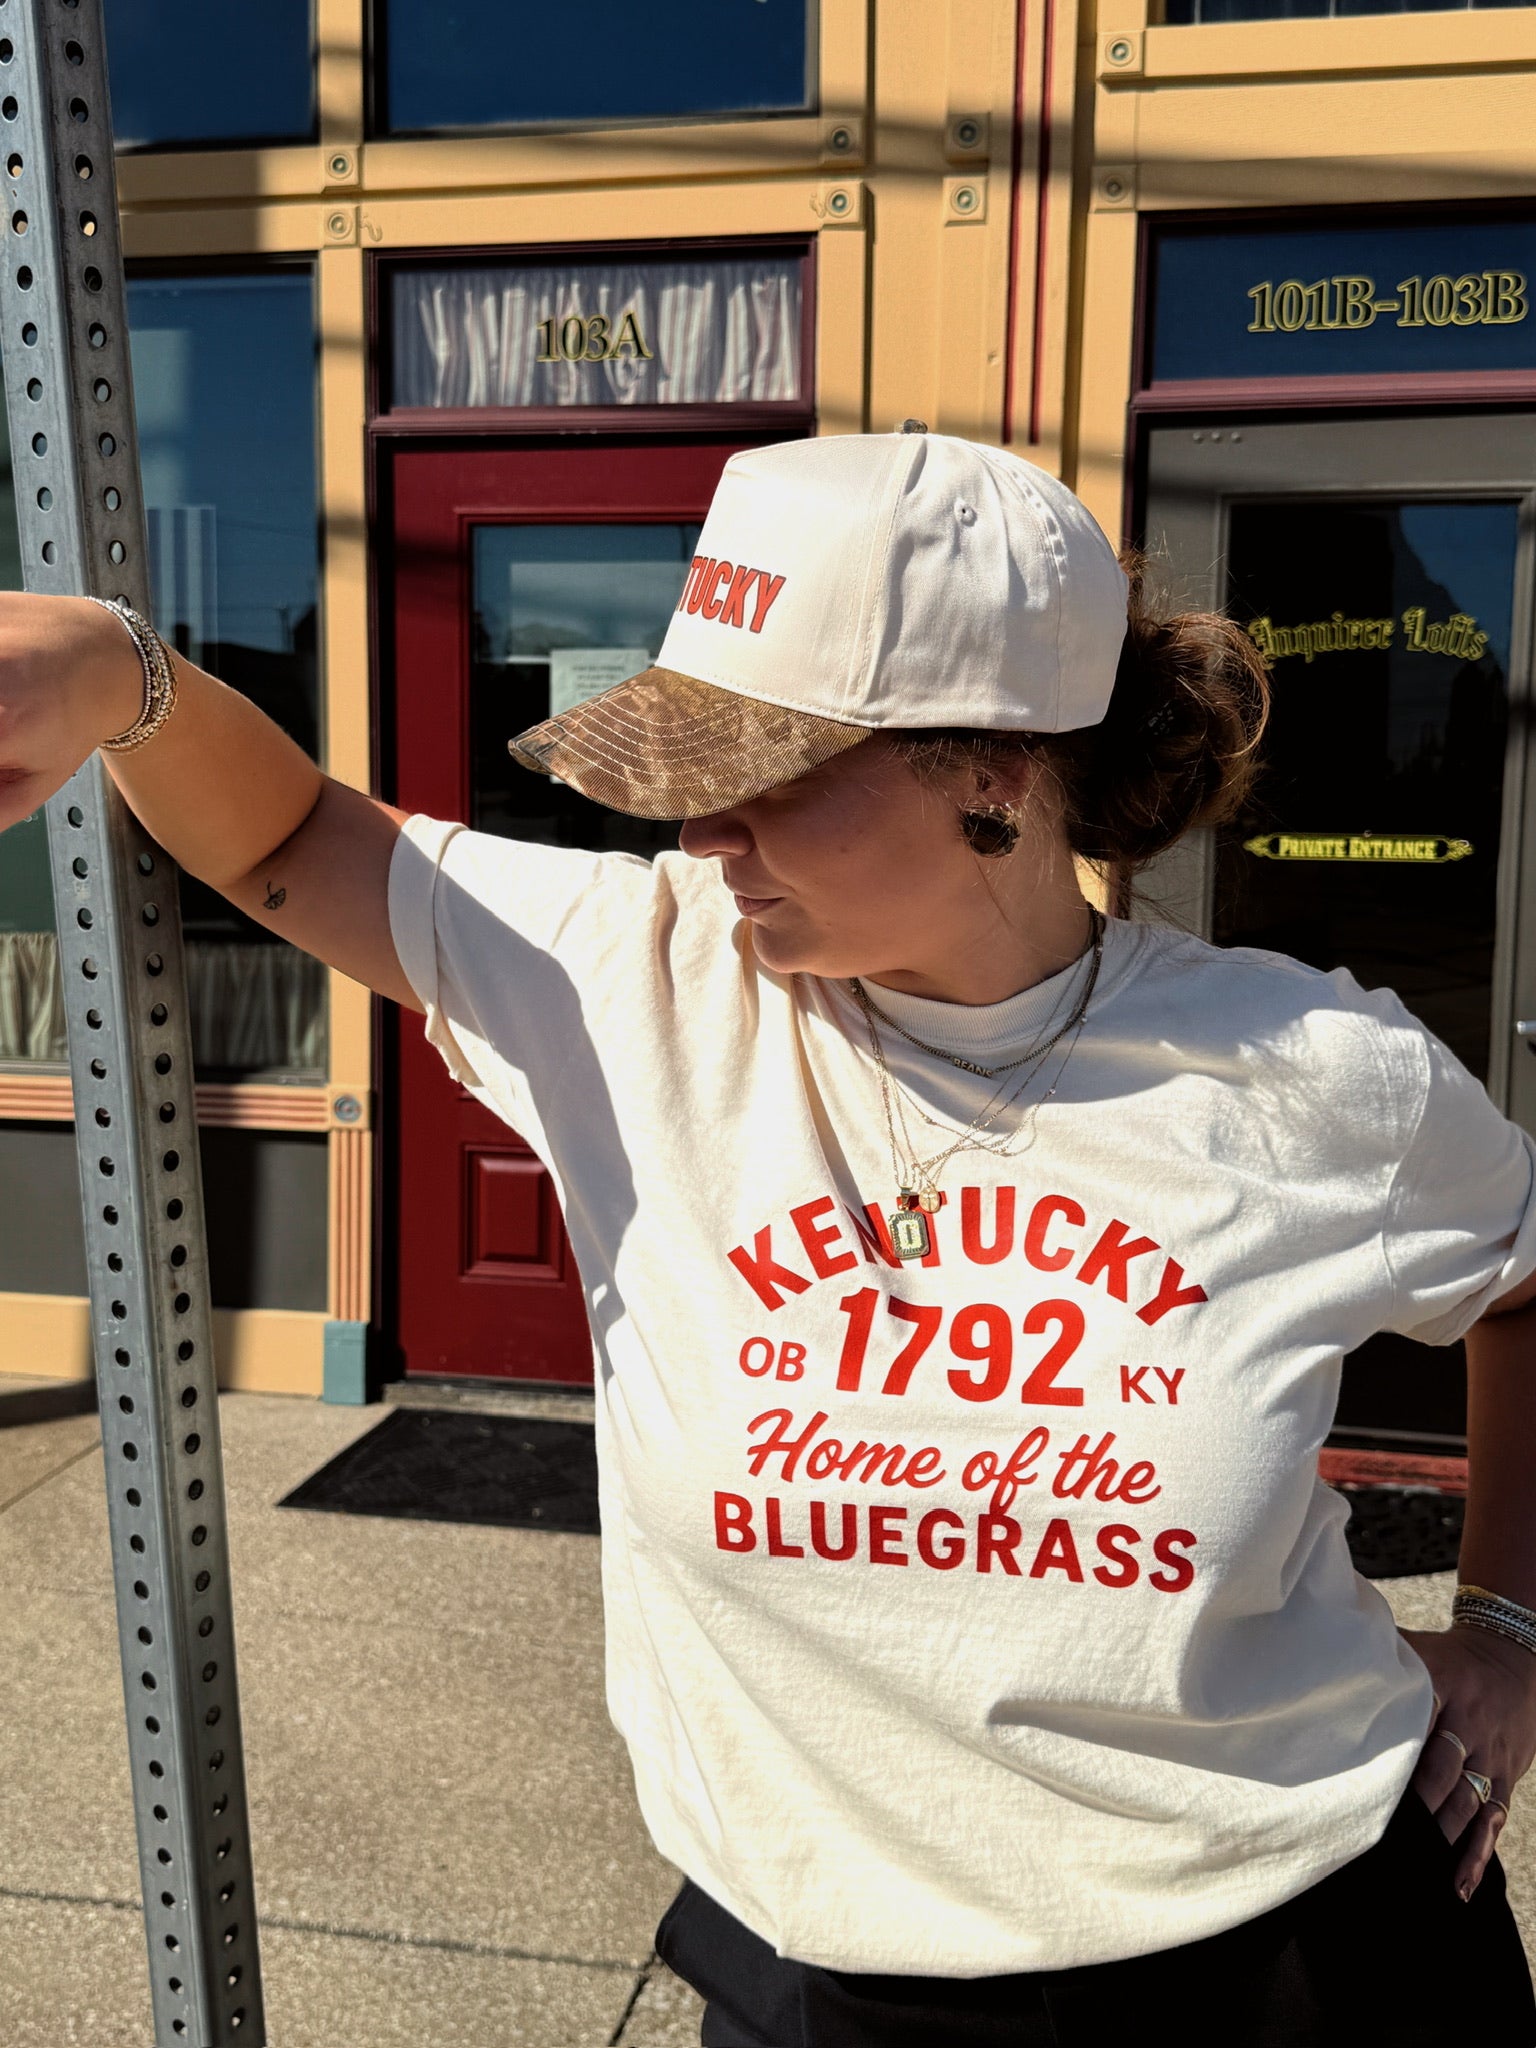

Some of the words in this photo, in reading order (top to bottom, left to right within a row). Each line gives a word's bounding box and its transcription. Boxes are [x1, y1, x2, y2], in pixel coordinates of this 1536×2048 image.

[536, 311, 654, 362] 103A
[1248, 271, 1529, 332] 101B-103B
[1401, 606, 1489, 660] Lofts
[738, 1337, 806, 1382] OB
[836, 1287, 1086, 1407] 1792
[1120, 1365, 1185, 1405] KY
[746, 1408, 946, 1489] Home
[962, 1426, 1050, 1516] of
[1052, 1432, 1162, 1505] the
[714, 1491, 1197, 1593] BLUEGRASS
